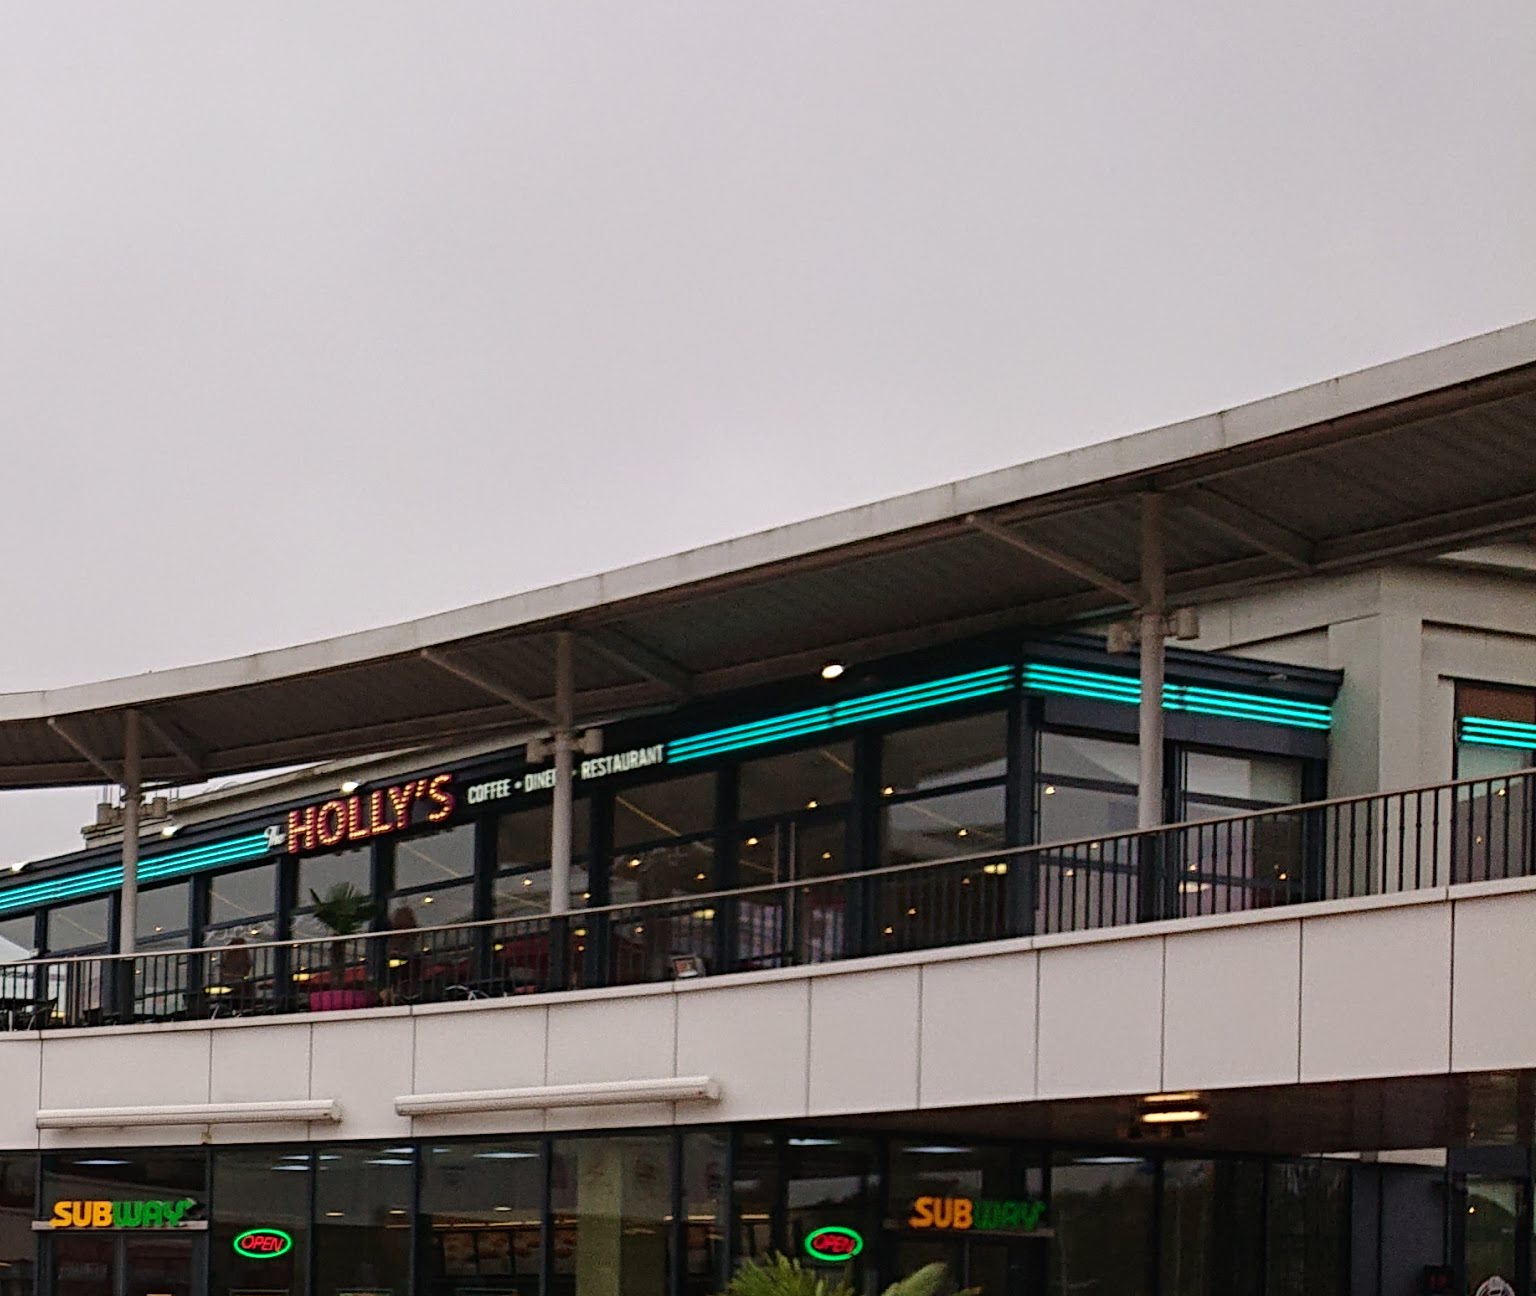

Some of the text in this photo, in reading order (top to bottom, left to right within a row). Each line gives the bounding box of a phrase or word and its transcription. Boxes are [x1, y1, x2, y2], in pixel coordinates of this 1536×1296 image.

[467, 744, 665, 804] COFFEE DINE RESTAURANT
[288, 774, 456, 854] HOLLY'S
[48, 1198, 196, 1229] SUBWAY
[908, 1196, 1048, 1231] SUBWAY
[240, 1234, 285, 1252] OPEN
[812, 1233, 856, 1253] OPEN
